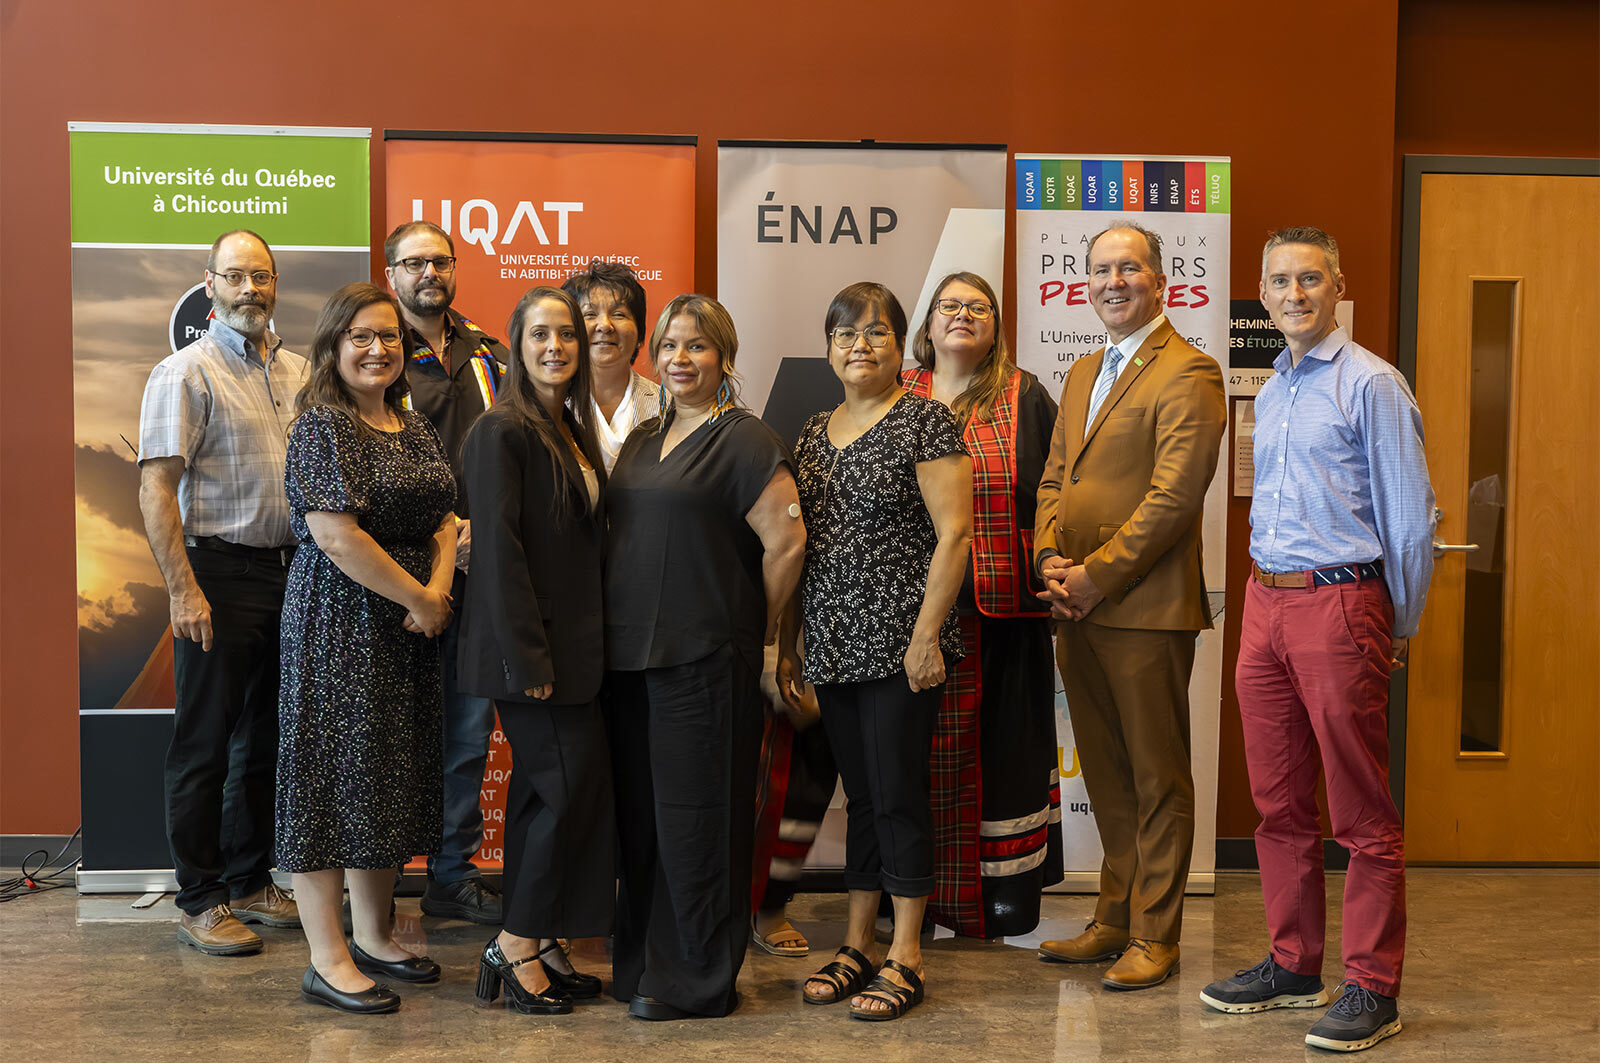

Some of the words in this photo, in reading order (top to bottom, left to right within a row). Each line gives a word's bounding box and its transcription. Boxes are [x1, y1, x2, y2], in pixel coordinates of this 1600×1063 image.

[103, 165, 215, 186] Université
[221, 168, 248, 187] du
[254, 168, 336, 188] Québec
[1025, 171, 1034, 203] UQAM
[1046, 176, 1055, 203] UQTR
[1066, 175, 1075, 203] UQAC
[1088, 175, 1097, 203] UQAR
[1108, 181, 1117, 204] UQO
[1129, 177, 1138, 204] UQAT
[1150, 182, 1159, 205] INRS
[1170, 179, 1179, 205] ENAP
[1189, 188, 1200, 205] ÉTS
[1210, 174, 1220, 205] TÉLUQ
[153, 194, 165, 213] à
[171, 194, 288, 214] Chicoutimi
[411, 198, 584, 255] UQAT
[757, 191, 898, 245] ÉNAP
[1041, 233, 1089, 245] PLA
[500, 253, 569, 266] UNIVERSITÉ
[572, 255, 589, 266] DU
[591, 253, 640, 267] QUÉBEC
[500, 268, 516, 279] EN
[1039, 280, 1210, 309] PEES
[1230, 318, 1276, 329] HEMINE
[1041, 330, 1108, 344] L'Universi
[1229, 337, 1245, 348] ES
[1246, 335, 1287, 348] ÉTUDE
[1057, 352, 1075, 362] un
[1229, 376, 1242, 385] 47
